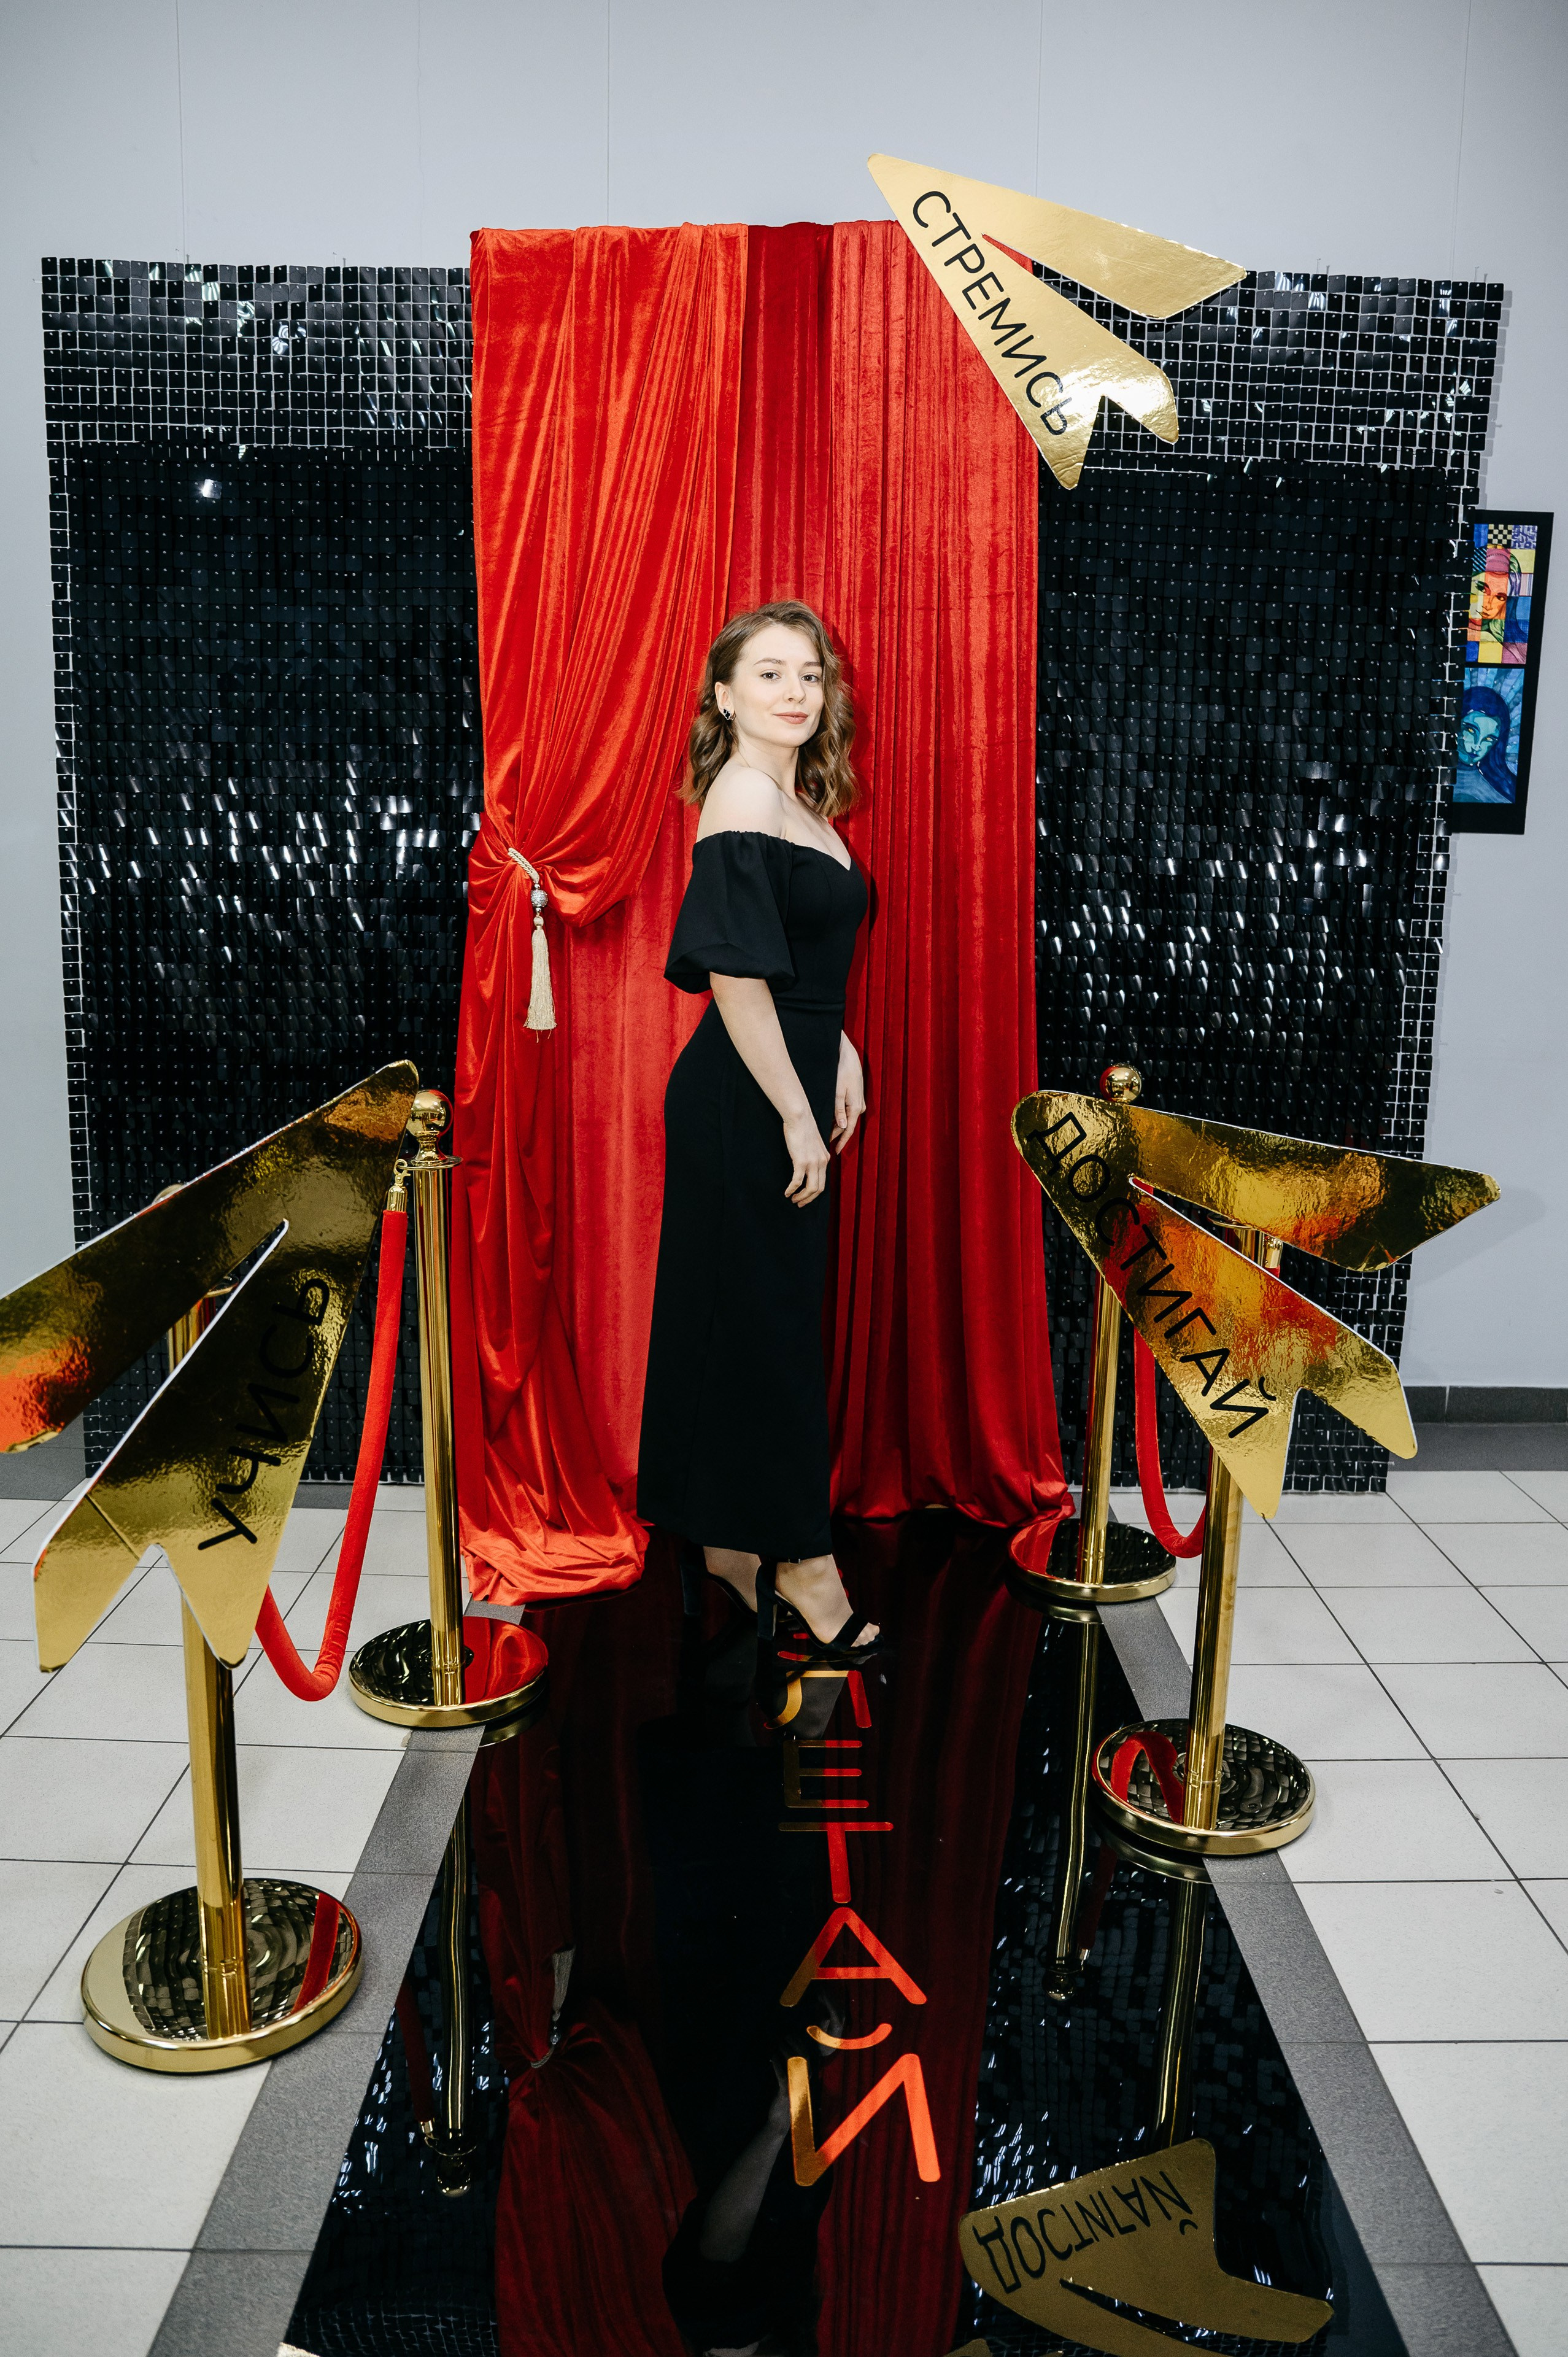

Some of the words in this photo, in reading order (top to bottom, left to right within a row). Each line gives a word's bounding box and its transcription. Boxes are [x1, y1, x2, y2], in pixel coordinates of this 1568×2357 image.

[913, 190, 1072, 436] СТРЕМИСЬ
[198, 1278, 330, 1550] УЧИСЬ
[1025, 1111, 1276, 1439] ДОСТИГАЙ
[763, 1567, 941, 2187] ЛЕТАЙ
